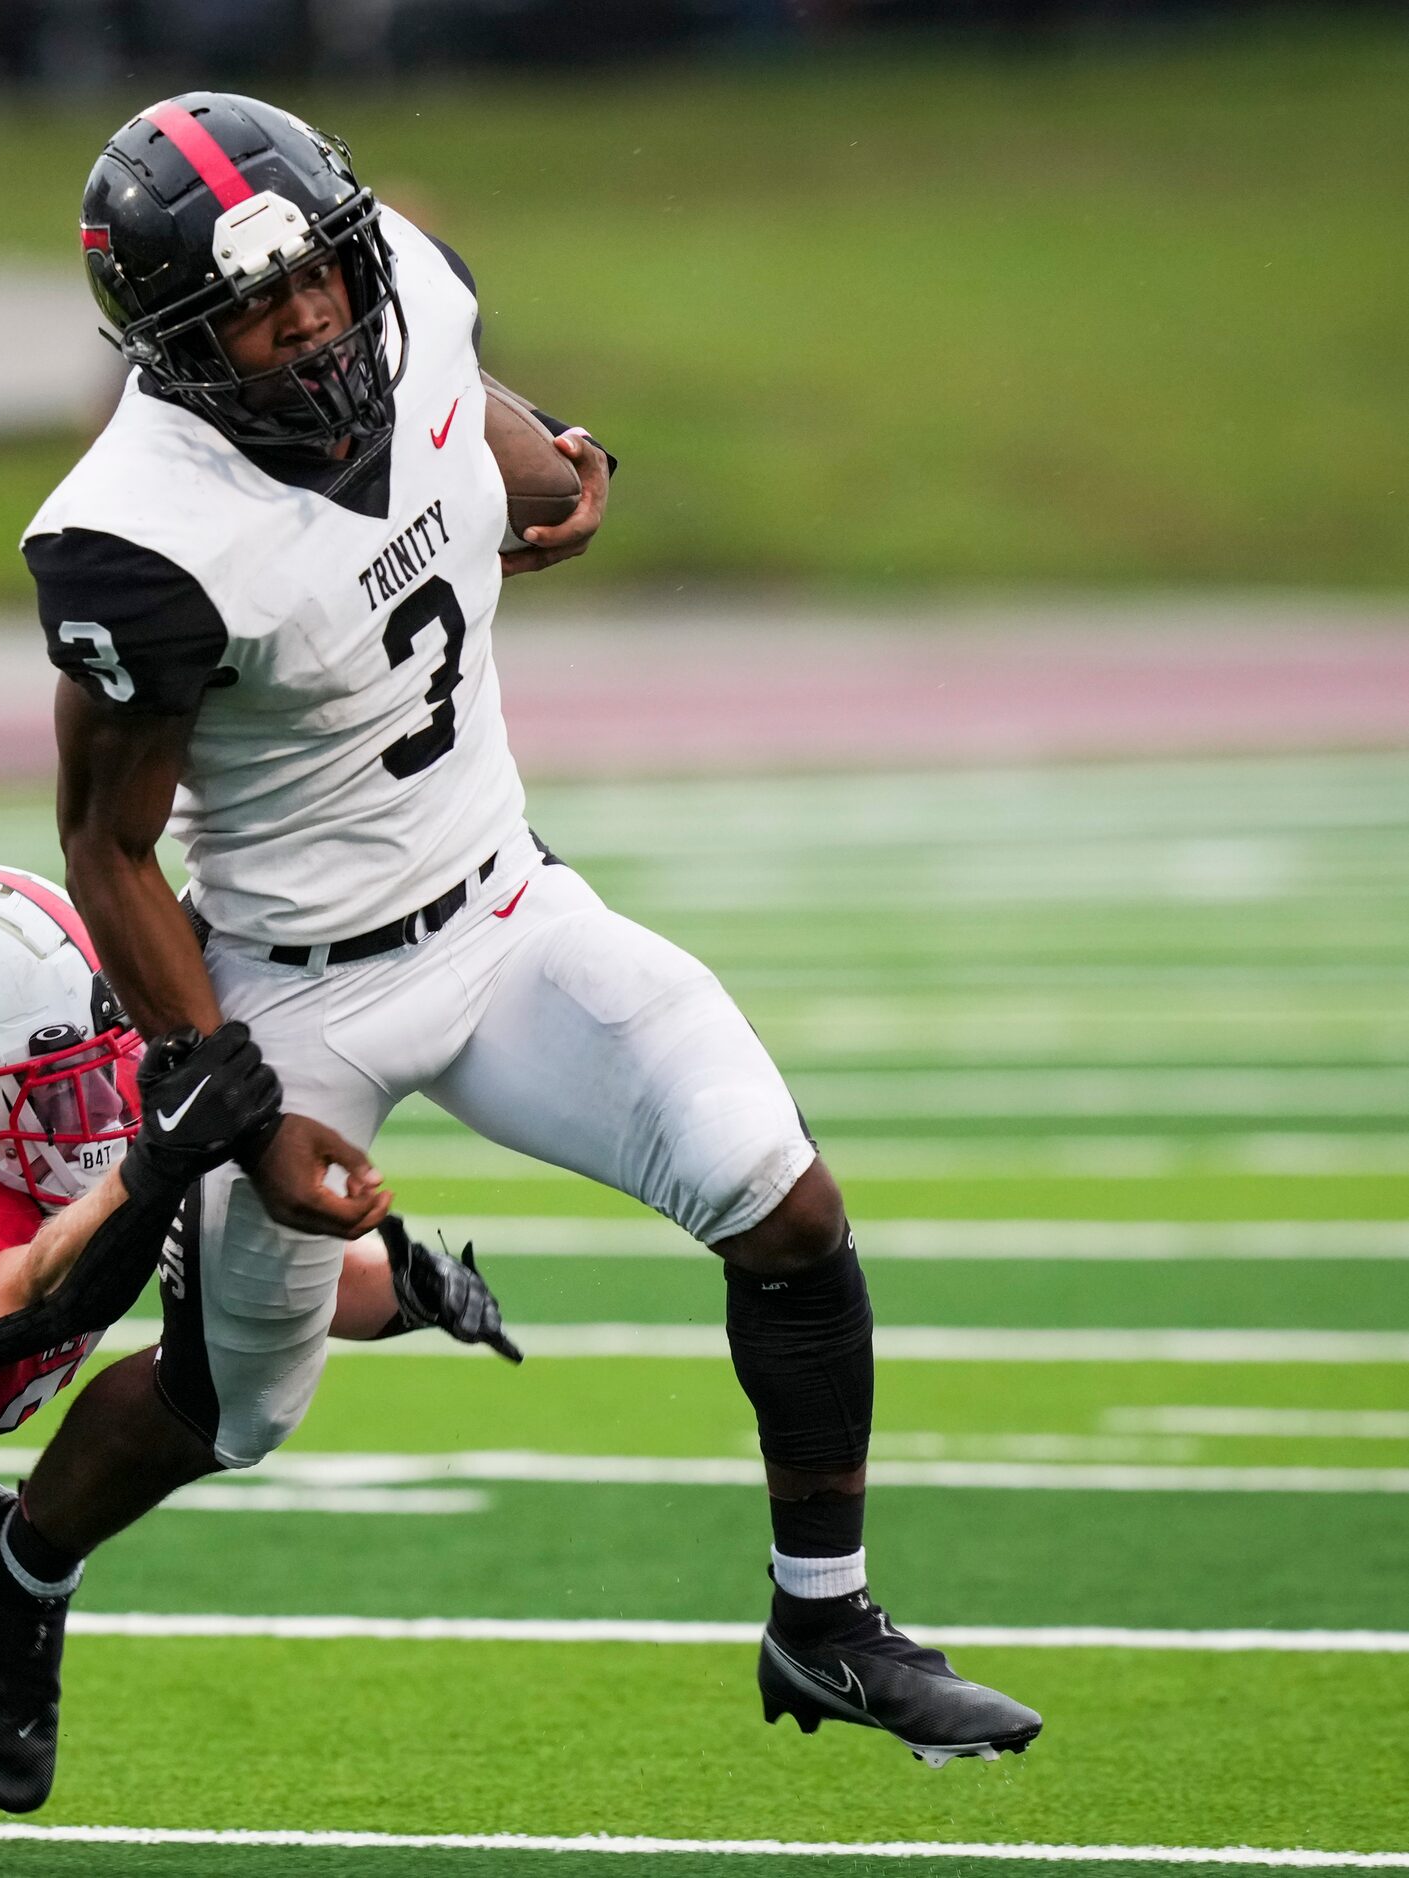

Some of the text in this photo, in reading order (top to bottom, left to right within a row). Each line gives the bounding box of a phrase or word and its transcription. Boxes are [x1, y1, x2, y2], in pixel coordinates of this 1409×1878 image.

[358, 499, 450, 611] TRINITY
[57, 620, 136, 702] 3
[382, 574, 466, 780] 3
[83, 1145, 111, 1169] B4T
